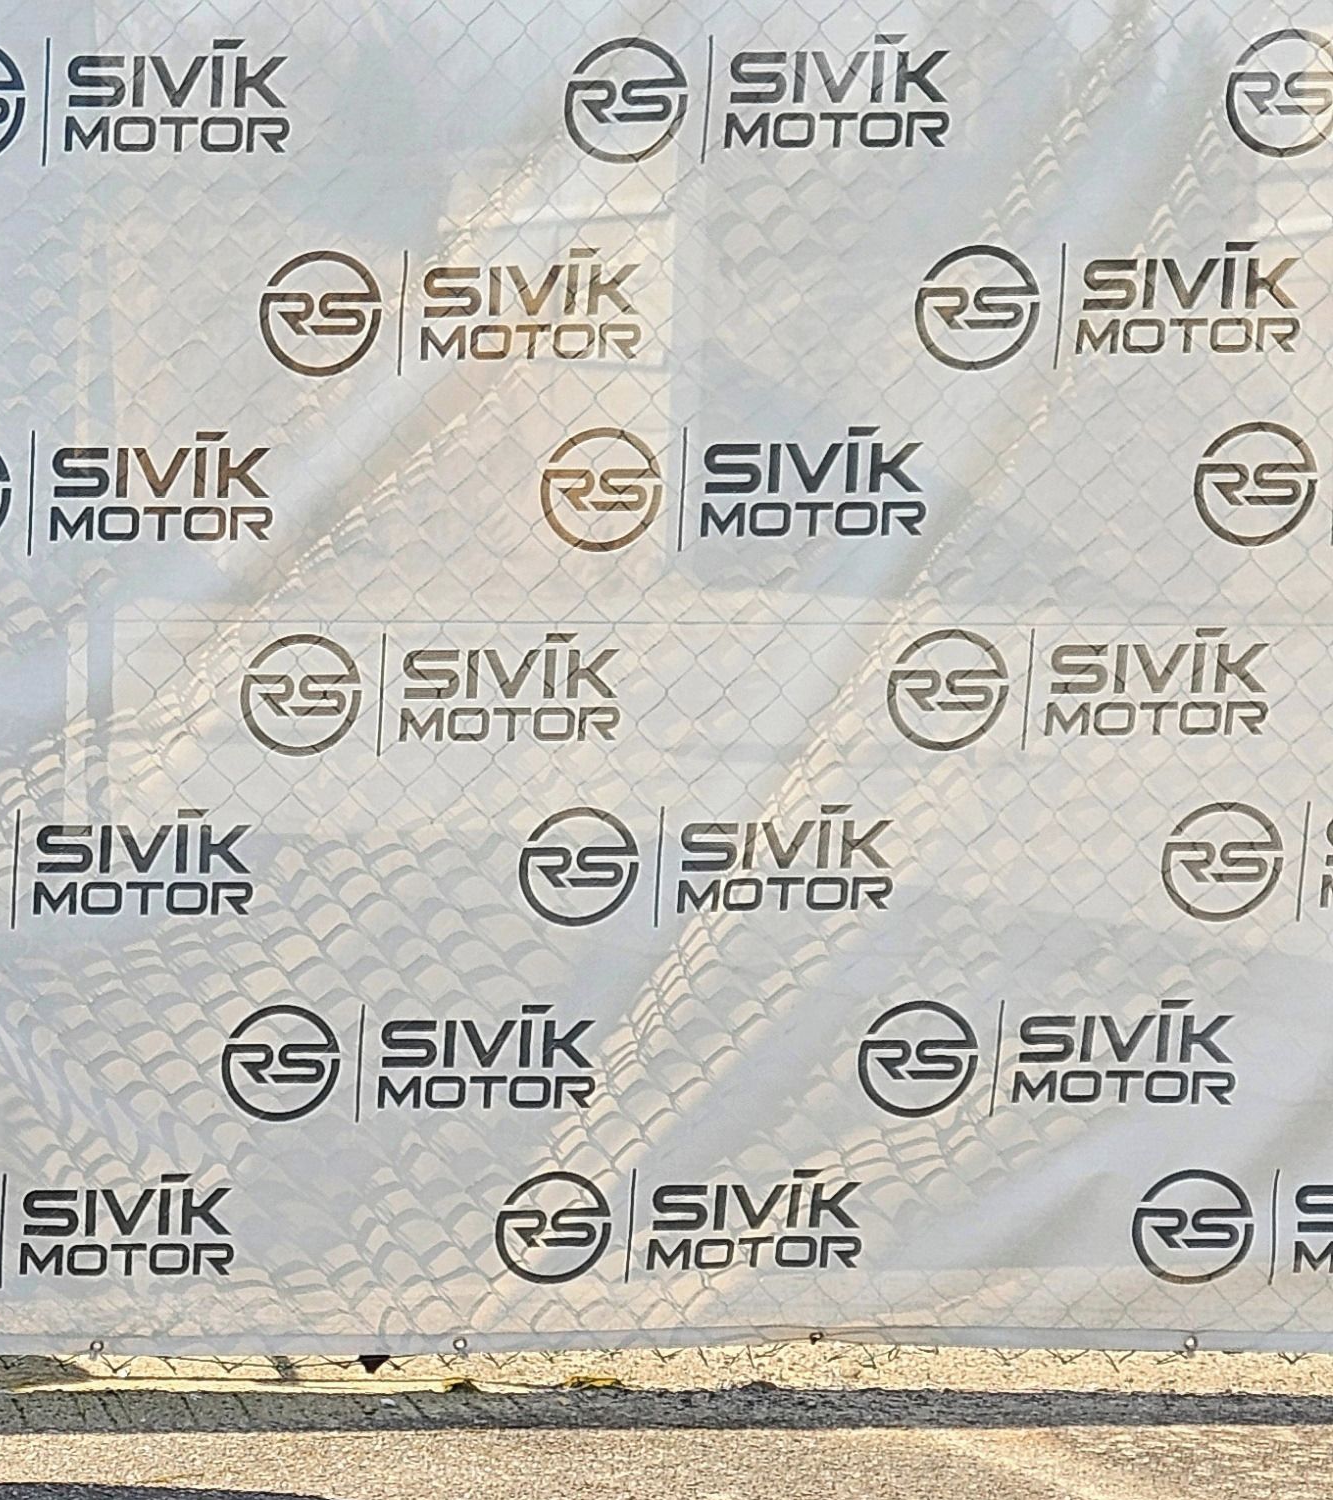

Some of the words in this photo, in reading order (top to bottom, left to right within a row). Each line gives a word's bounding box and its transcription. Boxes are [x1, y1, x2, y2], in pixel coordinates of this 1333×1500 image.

[64, 116, 290, 153] MOTOR
[724, 111, 950, 149] MOTOR
[420, 323, 642, 361] MOTOR
[1075, 317, 1300, 355] MOTOR
[49, 506, 274, 541] MOTOR
[700, 500, 925, 537] MOTOR
[398, 705, 620, 743] MOTOR
[1044, 701, 1270, 736] MOTOR
[33, 881, 254, 916] MOTOR
[676, 876, 894, 912] MOTOR
[377, 1075, 596, 1110] MOTOR
[1012, 1070, 1236, 1106] MOTOR
[19, 1242, 235, 1277] MOTOR
[646, 1237, 862, 1271] MOTOR
